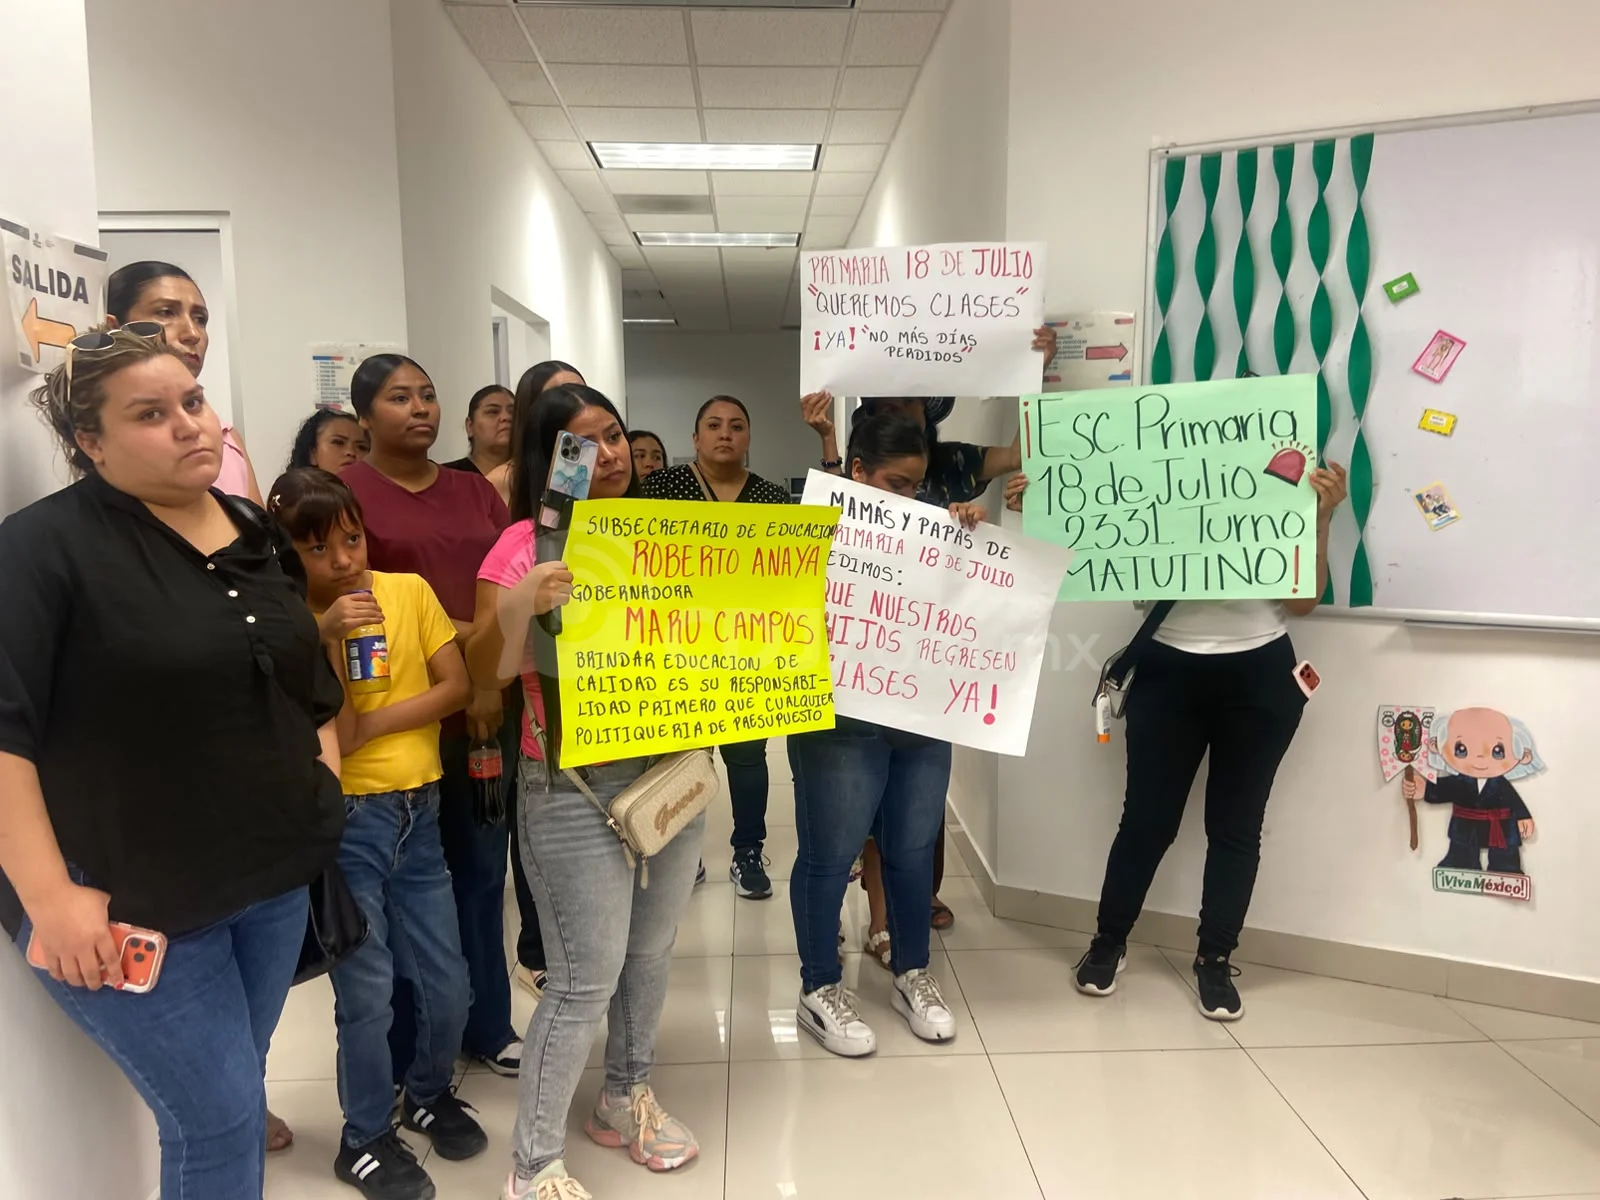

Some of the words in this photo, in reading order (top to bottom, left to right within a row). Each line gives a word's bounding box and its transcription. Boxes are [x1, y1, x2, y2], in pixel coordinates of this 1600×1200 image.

[12, 254, 89, 304] SALIDA
[808, 255, 890, 285] PRIMARIA
[906, 250, 930, 279] 18
[941, 250, 966, 277] DE
[971, 247, 1033, 279] JULIO
[814, 327, 856, 350] ¡YA!
[899, 326, 929, 345] MÁS
[936, 328, 977, 347] DÍAS
[1134, 392, 1297, 451] Primaria
[1038, 462, 1087, 516] 18
[1094, 460, 1149, 506] de
[1151, 457, 1258, 506] Julio
[587, 516, 728, 539] SUBSECRETARIO
[736, 522, 757, 539] DE
[829, 490, 896, 530] MAMÁS
[902, 512, 911, 531] Y
[917, 516, 974, 550] PAPÁS
[986, 540, 1012, 560] DE
[1178, 502, 1306, 544] Turno
[632, 539, 740, 579] ROBERTO
[751, 544, 821, 579] ANAYA
[826, 550, 903, 586] EDIMOS:
[833, 523, 904, 556] RIMARIA
[918, 545, 940, 568] 18
[945, 554, 963, 572] DE
[966, 559, 1015, 588] JULIO
[571, 583, 693, 602] GOBERNADORA
[624, 606, 701, 645] MARU
[714, 610, 815, 645] CAMPOS
[869, 590, 978, 642] NUESTROS
[575, 651, 655, 670] BRINDAR
[663, 653, 761, 671] EDUCACION
[774, 654, 799, 670] DE
[917, 638, 1017, 672] REGRESEN
[577, 675, 657, 693] CALIDAD
[668, 677, 689, 692] ES
[700, 677, 720, 692] SU
[730, 673, 829, 694] RESPONSABI-
[829, 653, 919, 700] LASES
[943, 678, 999, 726] YA!
[578, 700, 631, 717] LIDAD
[639, 699, 716, 717] PRIMERO
[724, 697, 755, 712] QUE
[765, 692, 835, 712] CUALQUIER
[575, 723, 703, 746] POLITIQUERIA
[708, 719, 727, 734] DE
[733, 709, 823, 732] PRESUPUESTO
